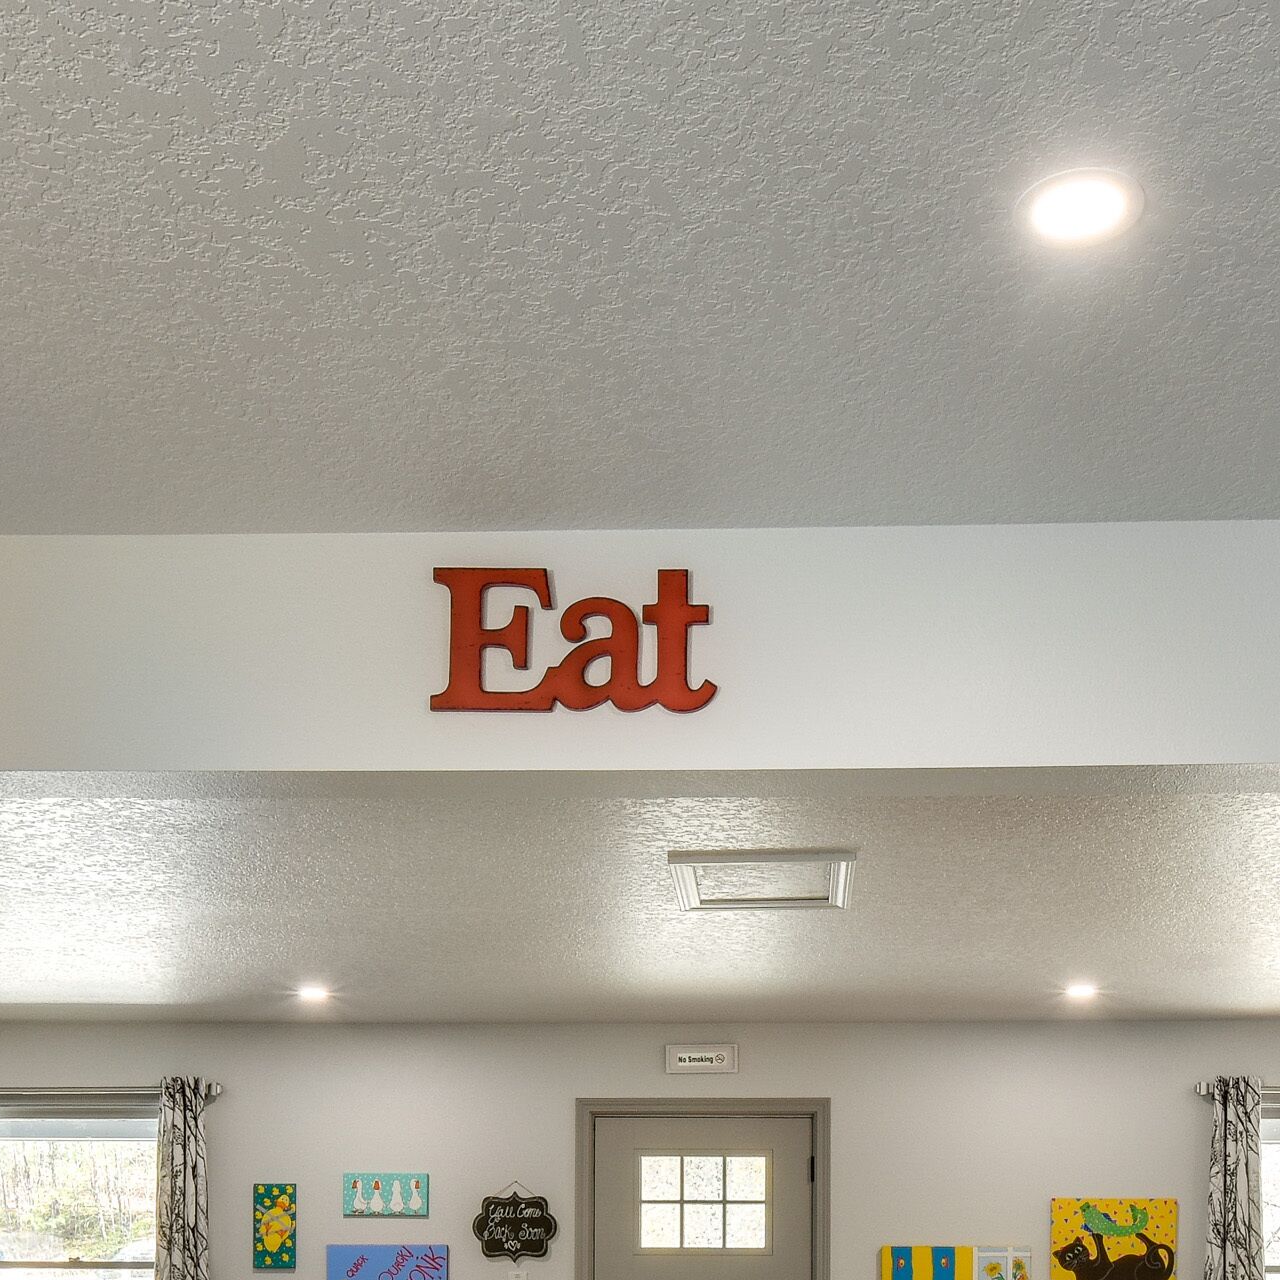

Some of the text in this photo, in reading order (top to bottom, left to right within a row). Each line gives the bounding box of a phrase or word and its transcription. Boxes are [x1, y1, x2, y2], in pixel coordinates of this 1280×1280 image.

[430, 567, 718, 713] Eat
[687, 1055, 714, 1064] Smoking
[517, 1203, 542, 1218] Come
[483, 1222, 546, 1241] Back Soon
[347, 1255, 369, 1278] QUACK
